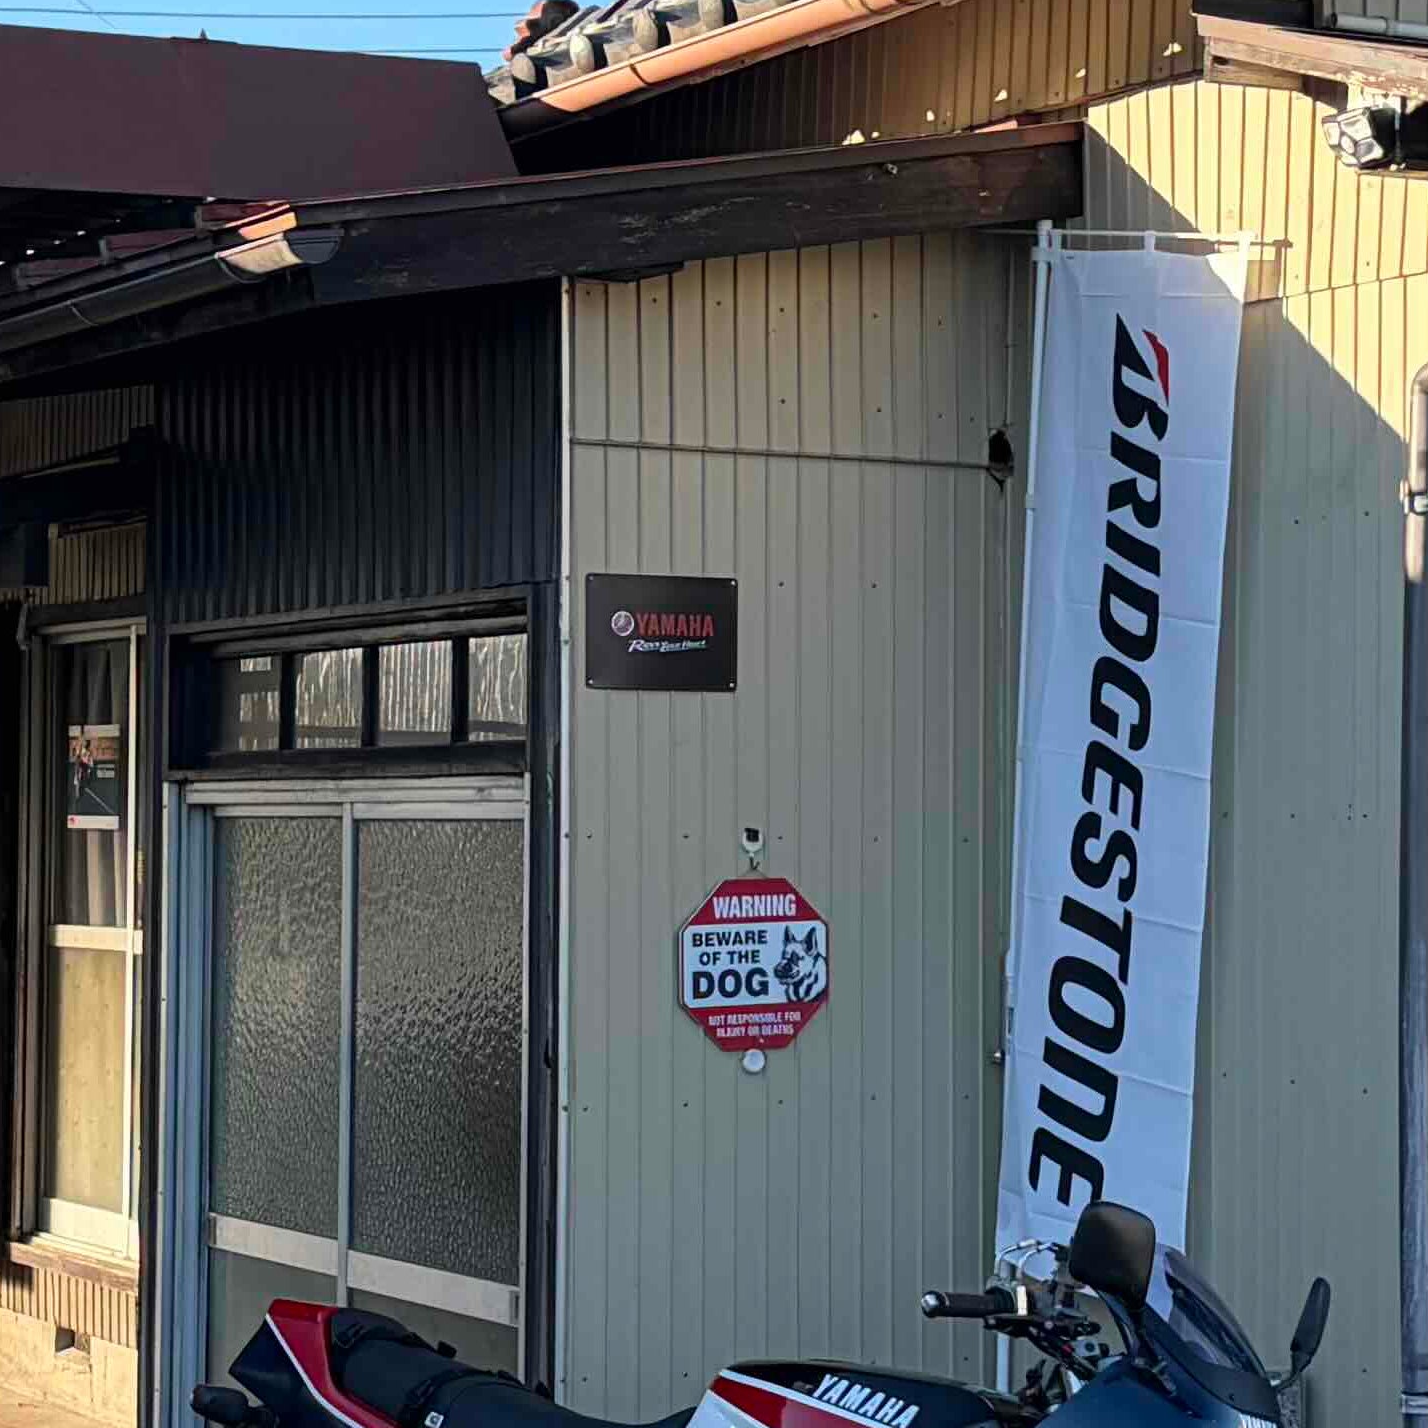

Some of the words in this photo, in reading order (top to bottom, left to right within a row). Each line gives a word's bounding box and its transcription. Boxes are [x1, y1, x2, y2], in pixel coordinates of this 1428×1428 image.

[636, 613, 714, 637] YAMAHA
[1028, 312, 1170, 1205] BRIDGESTONE
[713, 893, 797, 919] WARNING
[692, 929, 769, 948] BEWARE
[699, 952, 721, 966] OF
[726, 949, 761, 965] THE
[692, 967, 770, 1000] DOG
